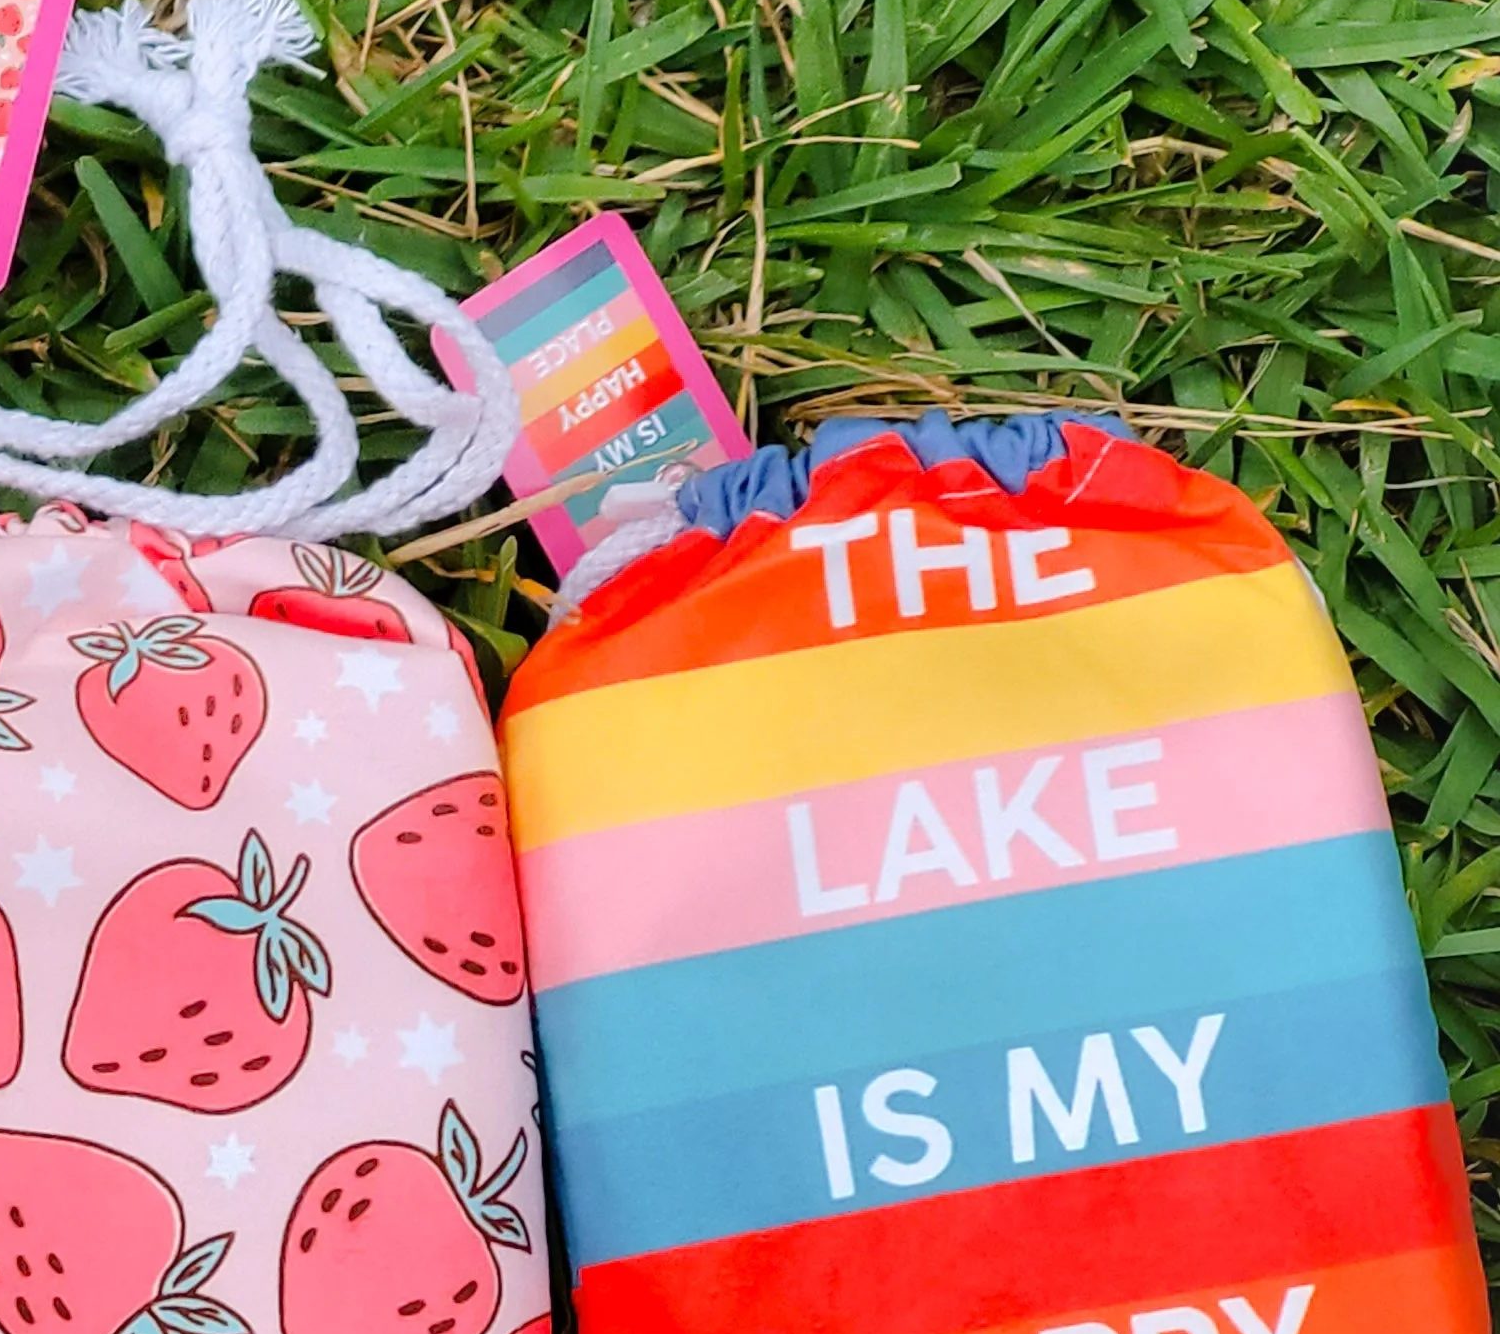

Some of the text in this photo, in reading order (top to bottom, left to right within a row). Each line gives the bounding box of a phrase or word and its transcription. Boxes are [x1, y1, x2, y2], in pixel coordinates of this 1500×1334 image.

[528, 310, 615, 380] PLACE
[557, 357, 649, 434] HAPPY
[593, 413, 667, 474] IS MY
[790, 507, 1096, 629] THE
[787, 737, 1179, 917] LAKE
[813, 1012, 1227, 1201] IS MY
